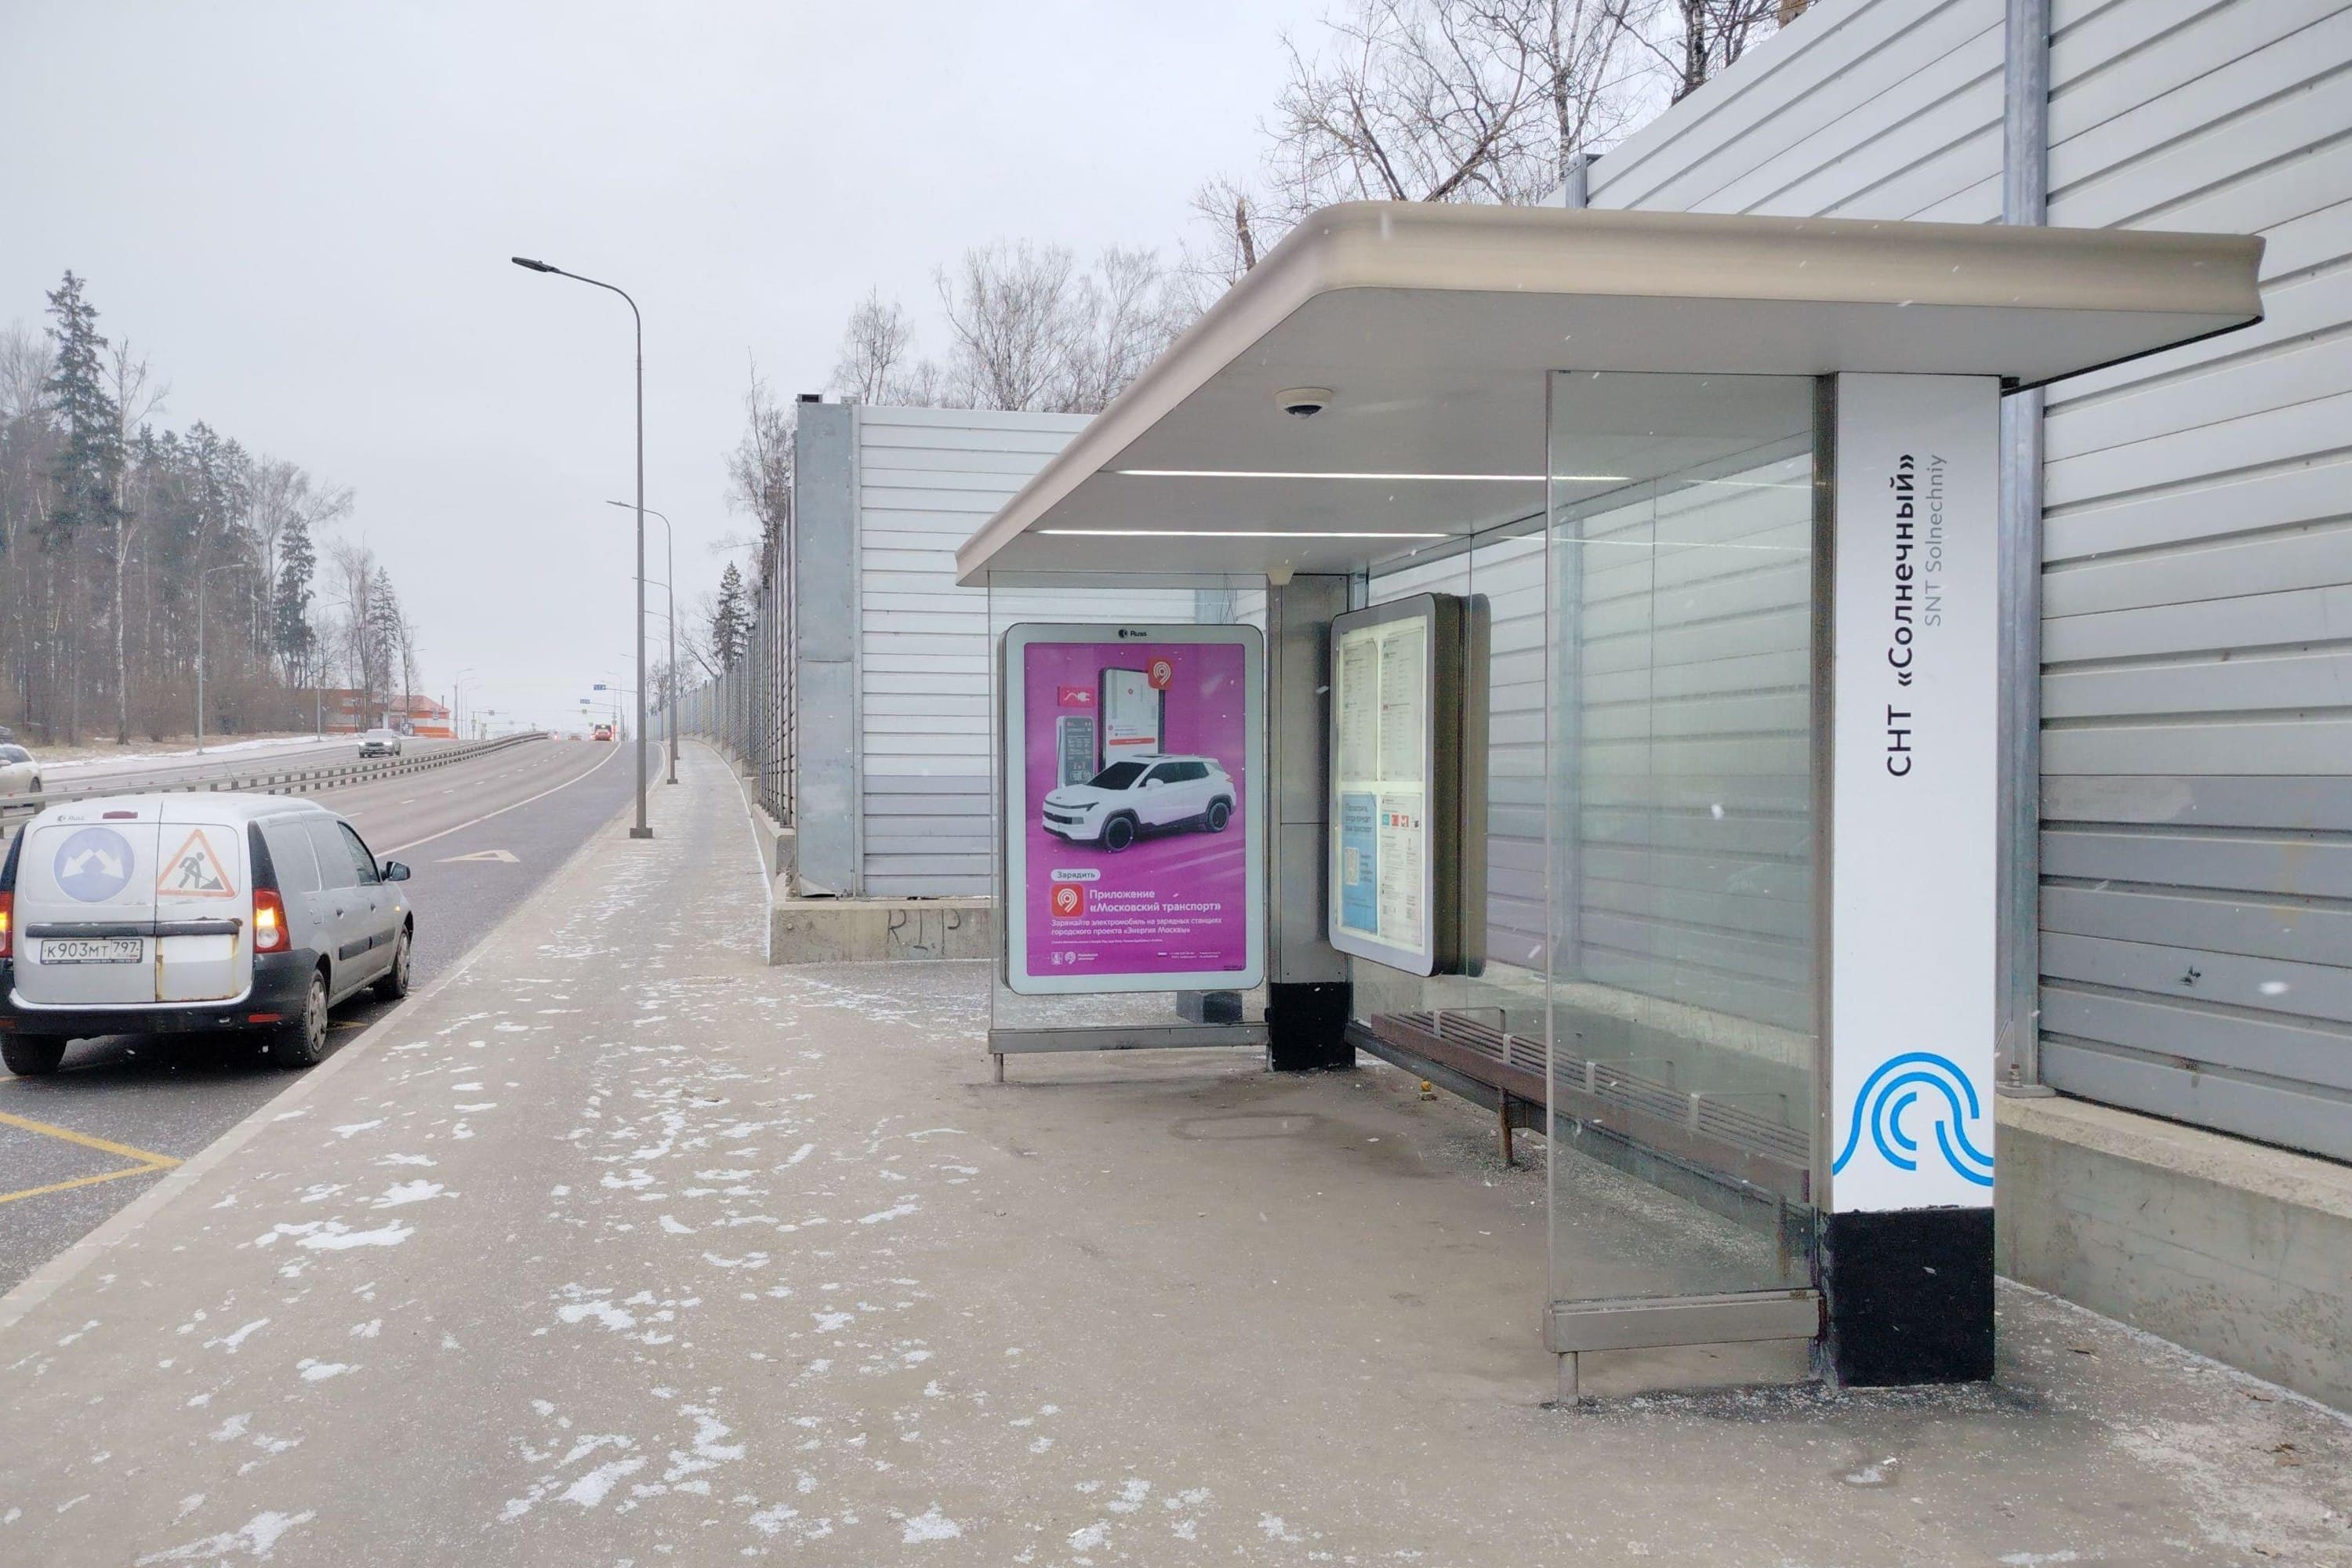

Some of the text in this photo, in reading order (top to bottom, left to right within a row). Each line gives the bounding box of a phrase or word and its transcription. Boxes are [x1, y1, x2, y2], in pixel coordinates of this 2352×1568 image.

[1924, 455, 1947, 627] SNT Solnechniy
[1886, 453, 1915, 777] СНТ «Солнечный»
[1057, 871, 1095, 880] Зарядить
[1090, 889, 1155, 900] Приложение
[1090, 902, 1221, 913] «Московский транспорт»
[1051, 919, 1090, 927] Заряжайте
[47, 942, 136, 957] К903МТ 797
